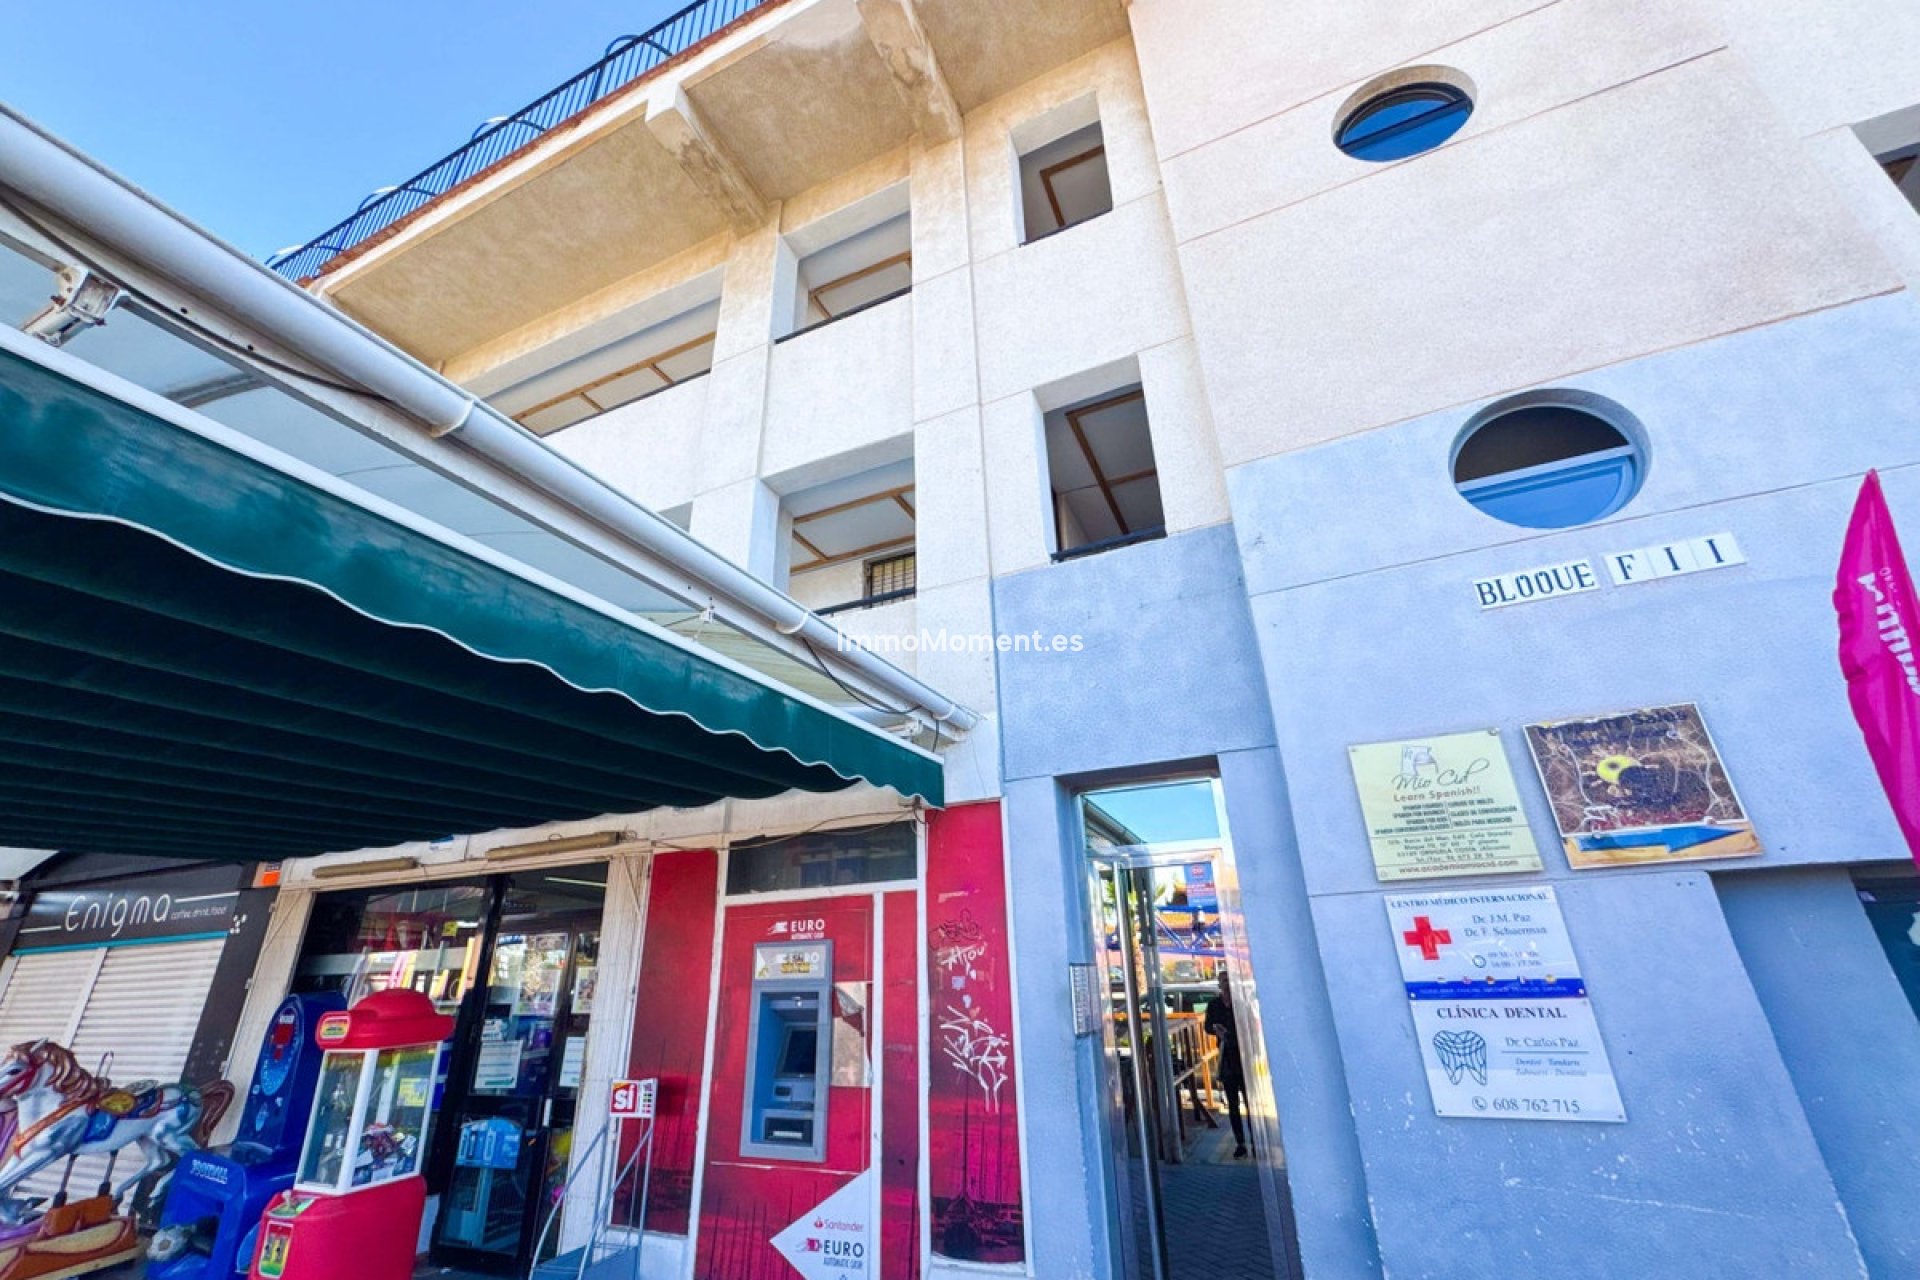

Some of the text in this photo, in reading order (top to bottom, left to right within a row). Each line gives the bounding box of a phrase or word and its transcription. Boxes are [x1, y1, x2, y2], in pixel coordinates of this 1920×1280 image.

[1393, 785, 1481, 802] Learn Spanish!!
[1391, 898, 1429, 908] CENTRO
[1469, 891, 1548, 905] INTERNACIONAL
[64, 892, 172, 938] Enigma
[791, 918, 825, 932] EURO
[1436, 1004, 1567, 1019] CLÍNICA DENTAL
[1524, 1036, 1558, 1048] Carlos
[1559, 1037, 1579, 1048] Paz
[1493, 1098, 1581, 1114] 608 762 715
[823, 1218, 864, 1232] Santander
[823, 1239, 865, 1258] EURO
